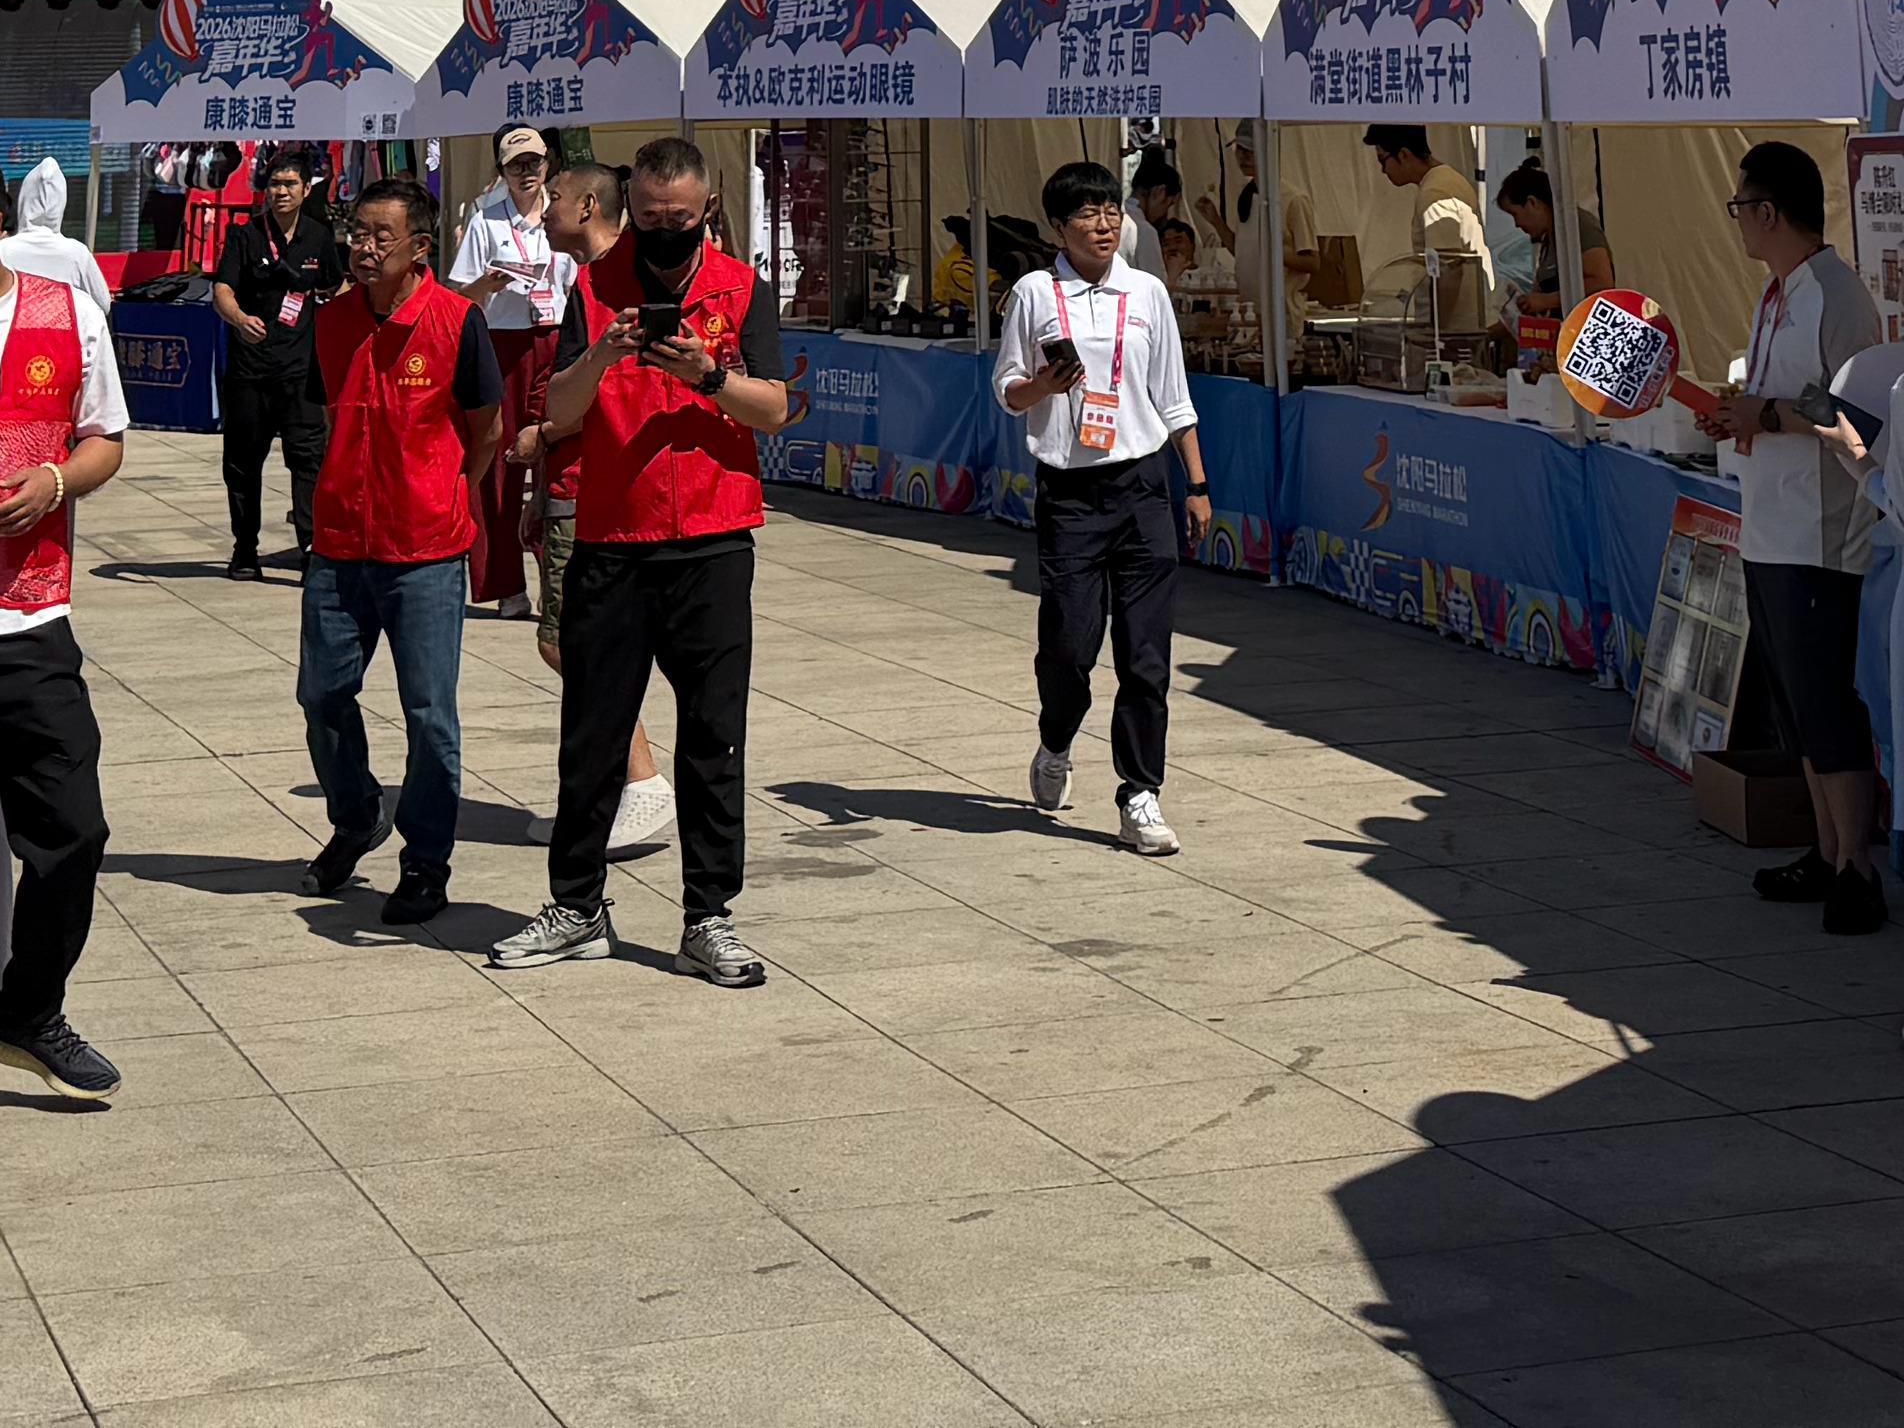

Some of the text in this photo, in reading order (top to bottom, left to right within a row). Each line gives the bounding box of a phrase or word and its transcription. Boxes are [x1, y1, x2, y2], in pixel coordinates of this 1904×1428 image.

[196, 13, 300, 41] 2026沈阳马拉松
[500, 13, 569, 69] 嘉年华
[199, 36, 282, 84] 嘉年华
[1059, 30, 1151, 80] 萨波乐园
[1310, 42, 1472, 105] 满堂街道黑林子村
[1639, 22, 1731, 101] 丁家房镇
[506, 75, 584, 120] 康膝通宝
[717, 61, 916, 107] 本执&欧克利运动眼镜
[1046, 84, 1162, 115] 肌肤的天然洗护乐园
[204, 94, 297, 131] 康膝通宝
[815, 367, 879, 397] 沈阳马拉松
[1396, 453, 1468, 503] 沈阳马拉松
